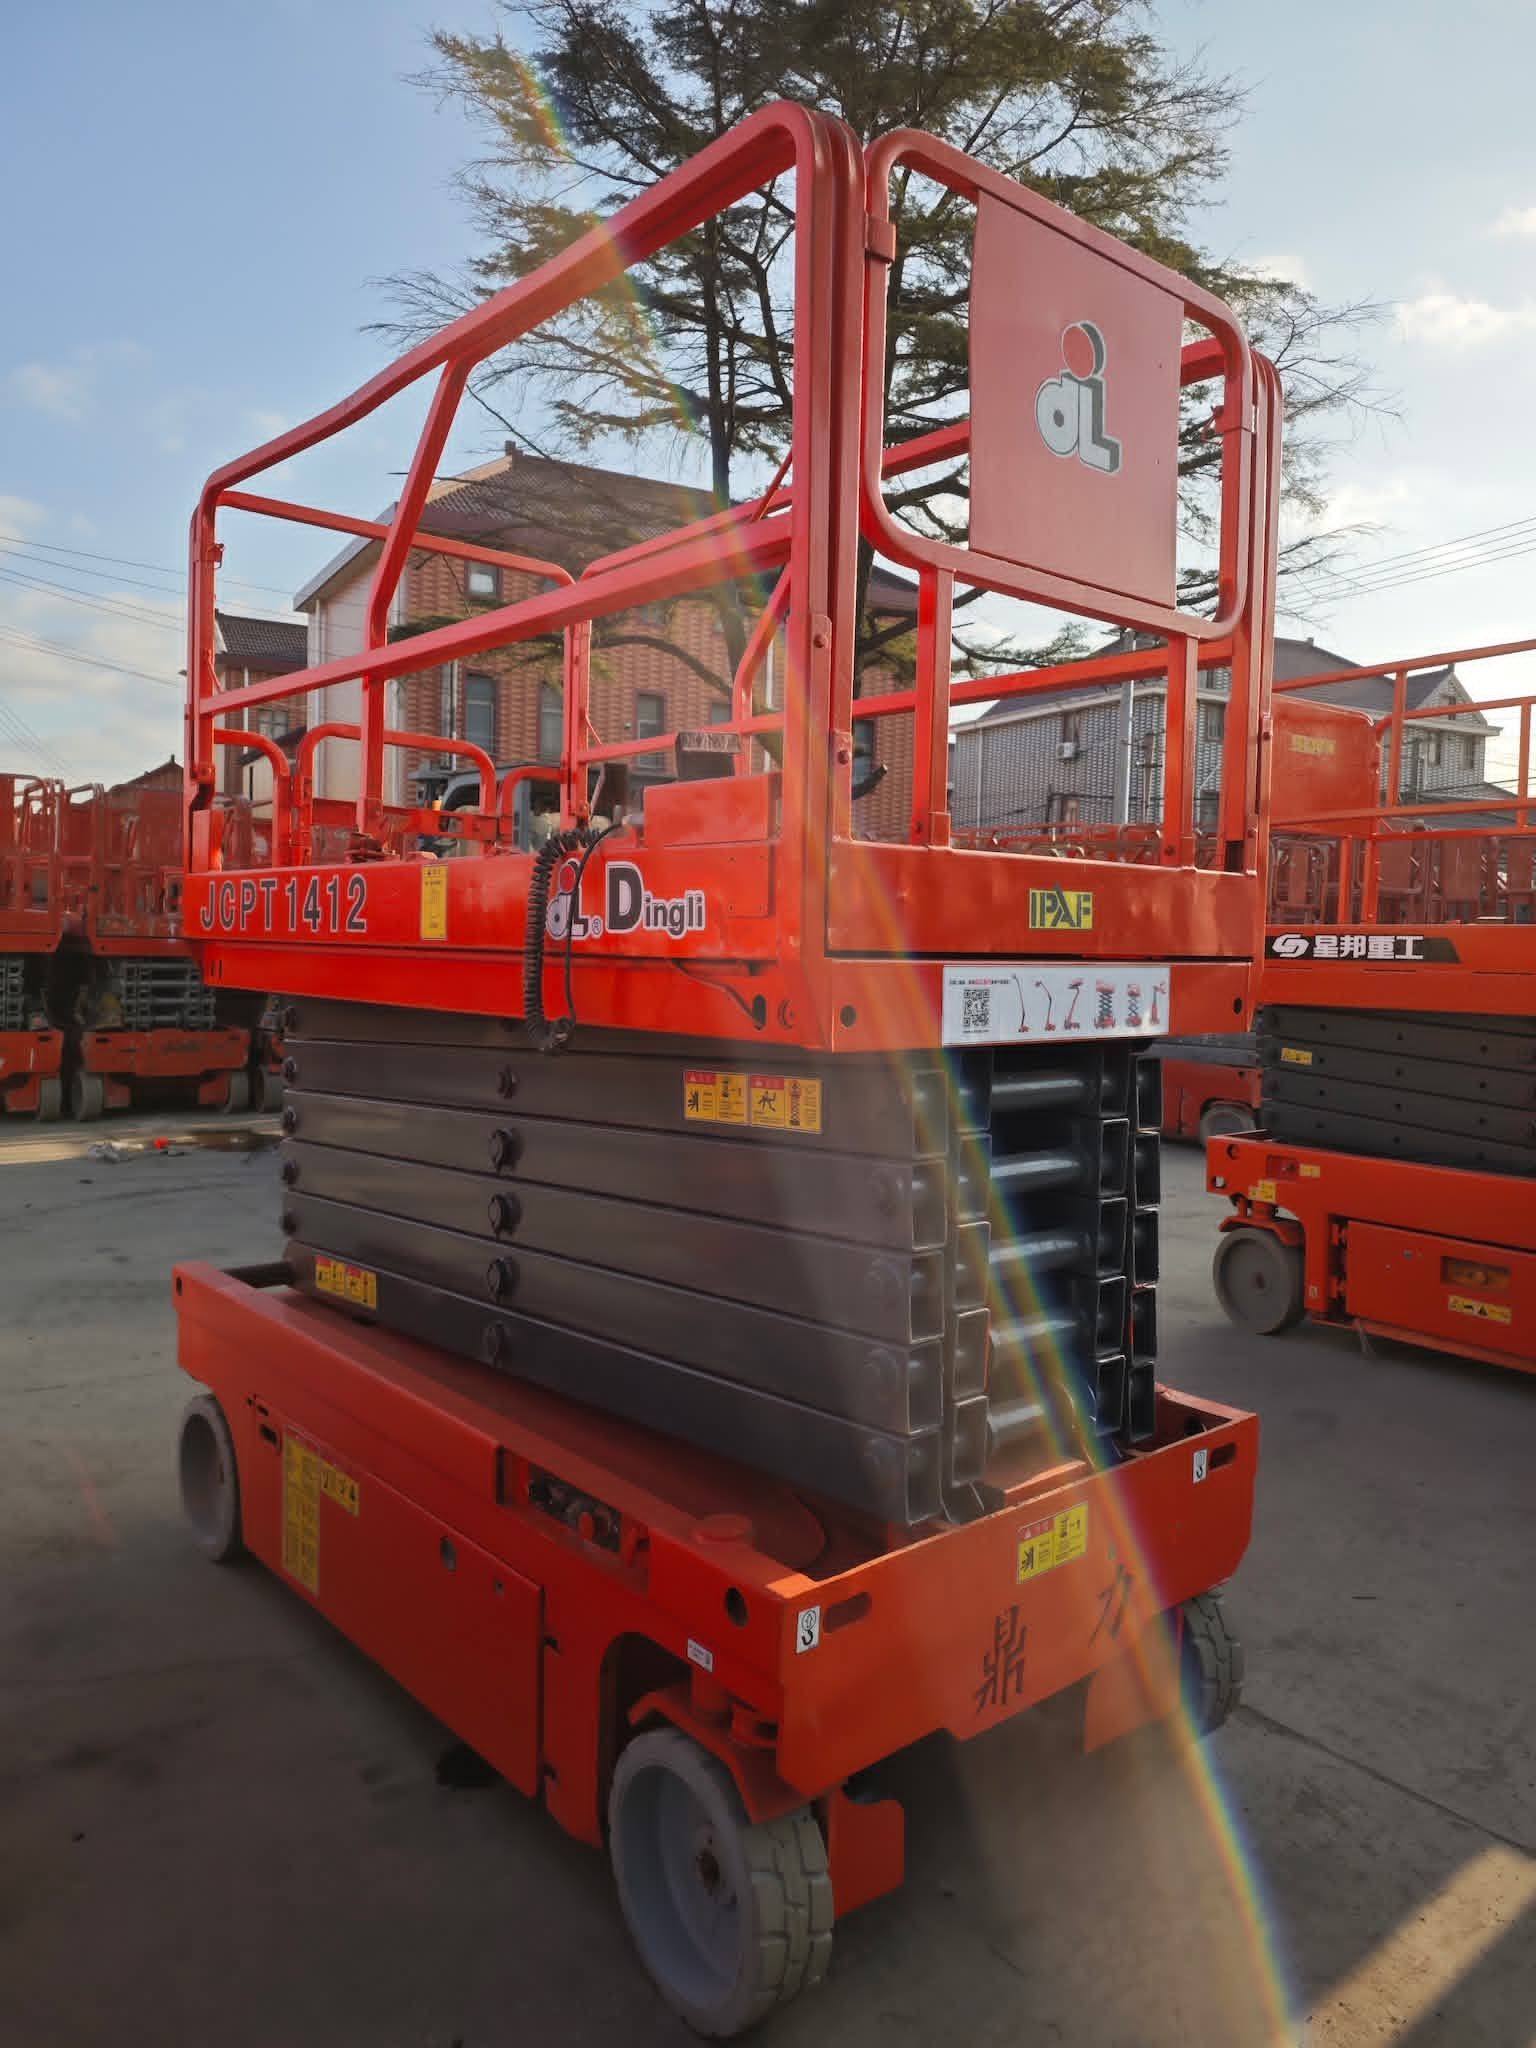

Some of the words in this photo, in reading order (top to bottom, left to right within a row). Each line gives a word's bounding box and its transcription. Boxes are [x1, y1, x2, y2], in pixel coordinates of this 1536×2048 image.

[605, 861, 705, 939] Dingli
[1031, 881, 1091, 927] IPAF
[1313, 934, 1424, 960] 星邦重工
